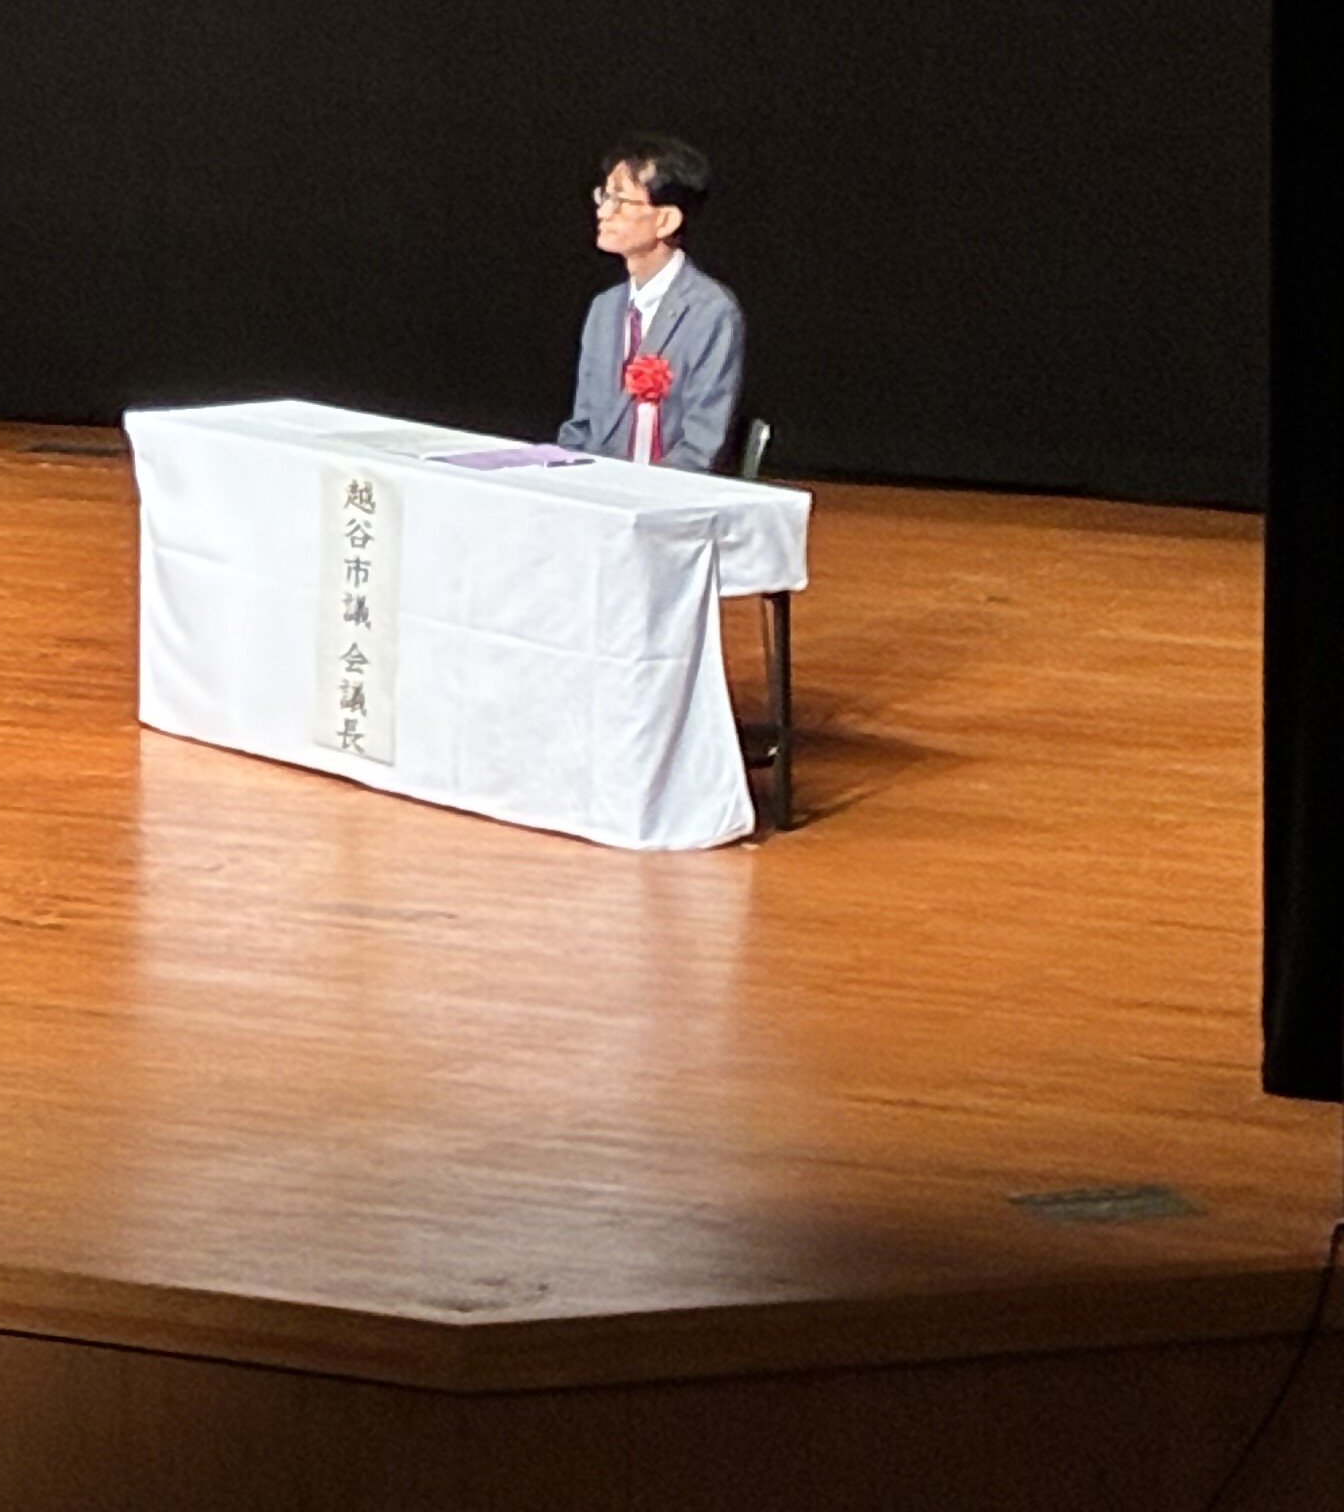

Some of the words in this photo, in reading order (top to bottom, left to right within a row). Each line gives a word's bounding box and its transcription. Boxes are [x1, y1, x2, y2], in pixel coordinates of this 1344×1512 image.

[336, 479, 376, 753] 越谷市議会議長
